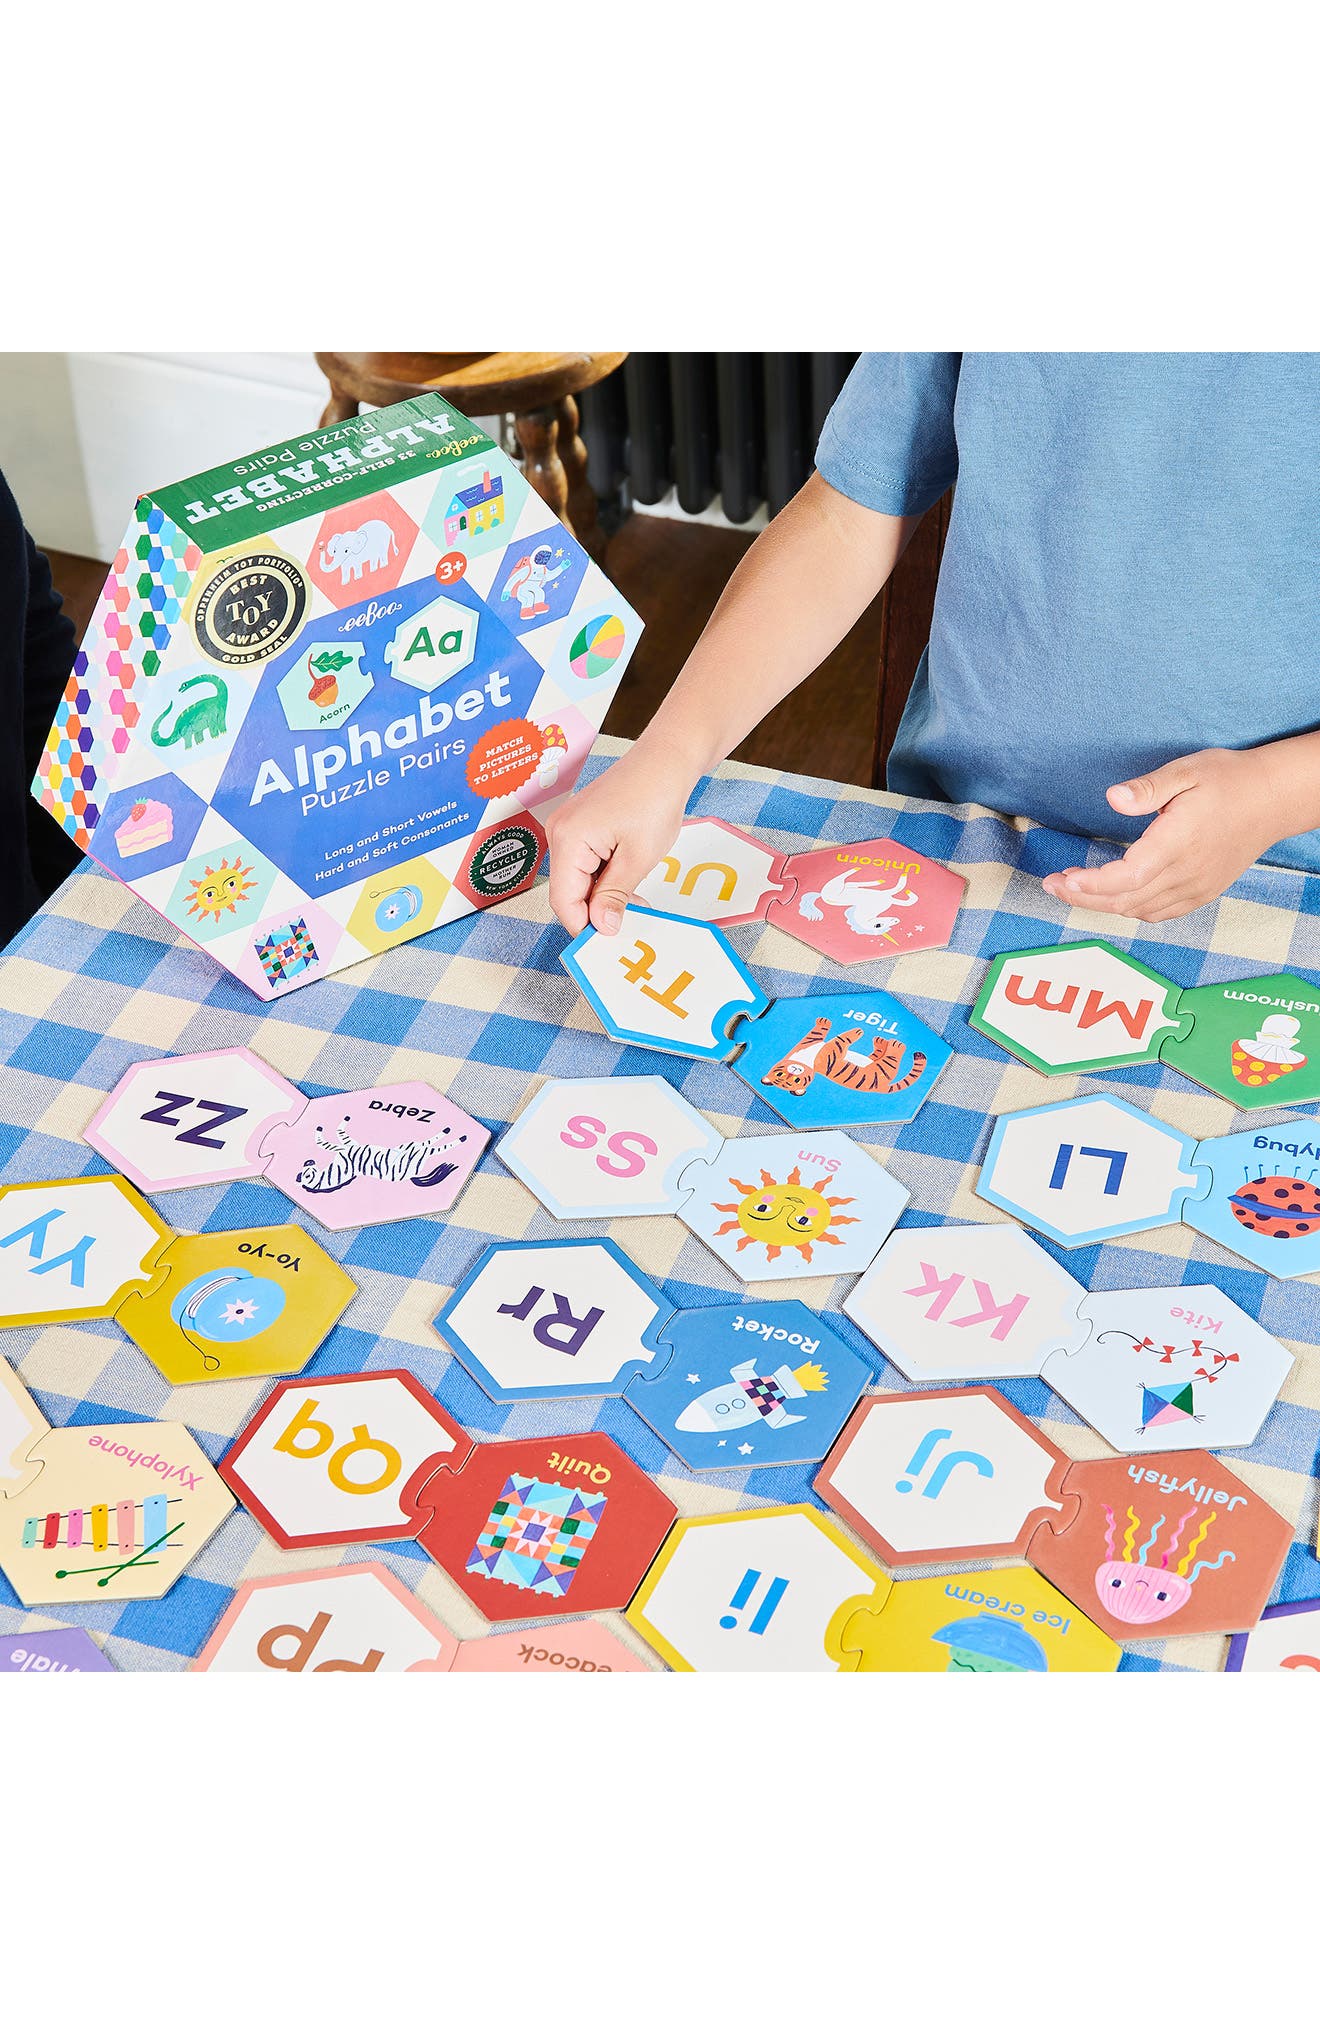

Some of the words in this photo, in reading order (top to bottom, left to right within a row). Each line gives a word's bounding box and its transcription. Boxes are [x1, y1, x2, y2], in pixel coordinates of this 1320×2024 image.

[298, 423, 377, 452] Puzzle
[184, 413, 456, 524] ALPHABET
[233, 452, 296, 475] Pairs
[398, 450, 417, 460] 33
[258, 459, 395, 512] SELF-CORRECTING
[234, 559, 253, 571] TOY
[439, 560, 464, 580] 3+
[229, 575, 267, 595] BEST
[226, 590, 273, 625] TOY
[226, 619, 279, 645] AWARD
[403, 626, 463, 661] Aa
[222, 654, 255, 663] GOLD
[260, 635, 287, 657] SEAL
[319, 703, 351, 724] Acorn
[249, 670, 512, 807] Alphabet
[486, 736, 524, 758] MATCH
[473, 774, 489, 785] TO
[491, 752, 538, 778] LETTERS
[480, 744, 532, 772] PICTURES
[300, 769, 391, 817] Puzzle
[399, 738, 466, 777] Pairs
[315, 864, 344, 882] Hard
[347, 853, 370, 868] and
[372, 841, 399, 858] Soft
[401, 812, 470, 846] Consonants
[324, 844, 353, 861] Long
[357, 832, 379, 848] and
[382, 817, 415, 837] Short
[417, 800, 458, 822] Vowels
[482, 834, 506, 854] ALWAYS
[507, 831, 525, 839] GOOD
[480, 849, 528, 874] RECYCLED
[492, 842, 514, 854] WOMAN
[492, 846, 514, 857] OWNED
[836, 852, 921, 876] Unicorn
[493, 865, 517, 878] MOTHER
[618, 940, 696, 1020] Tt
[1004, 974, 1154, 1040] Mm
[1223, 990, 1320, 1016] ushroom
[842, 1009, 899, 1035] Tiger
[140, 1091, 248, 1150] Zz
[368, 1100, 436, 1124] Zebra
[559, 1115, 658, 1178] Ss
[798, 1150, 842, 1173] Sun
[1049, 1144, 1128, 1196] Ll
[0, 1208, 96, 1288] Yy
[238, 1243, 301, 1273] Yo-yo
[902, 1261, 1031, 1342] Kk
[496, 1285, 605, 1357] Rr
[732, 1315, 821, 1355] Rocket
[1169, 1305, 1223, 1335] Kite
[88, 1435, 204, 1491] Xylophone
[273, 1398, 402, 1495] Qq
[547, 1452, 612, 1485] Quilt
[895, 1428, 994, 1500] Jj
[1128, 1464, 1248, 1511] Jellyfish
[719, 1568, 790, 1636] Ii
[945, 1583, 1026, 1617] cream
[1032, 1611, 1072, 1635] Ice
